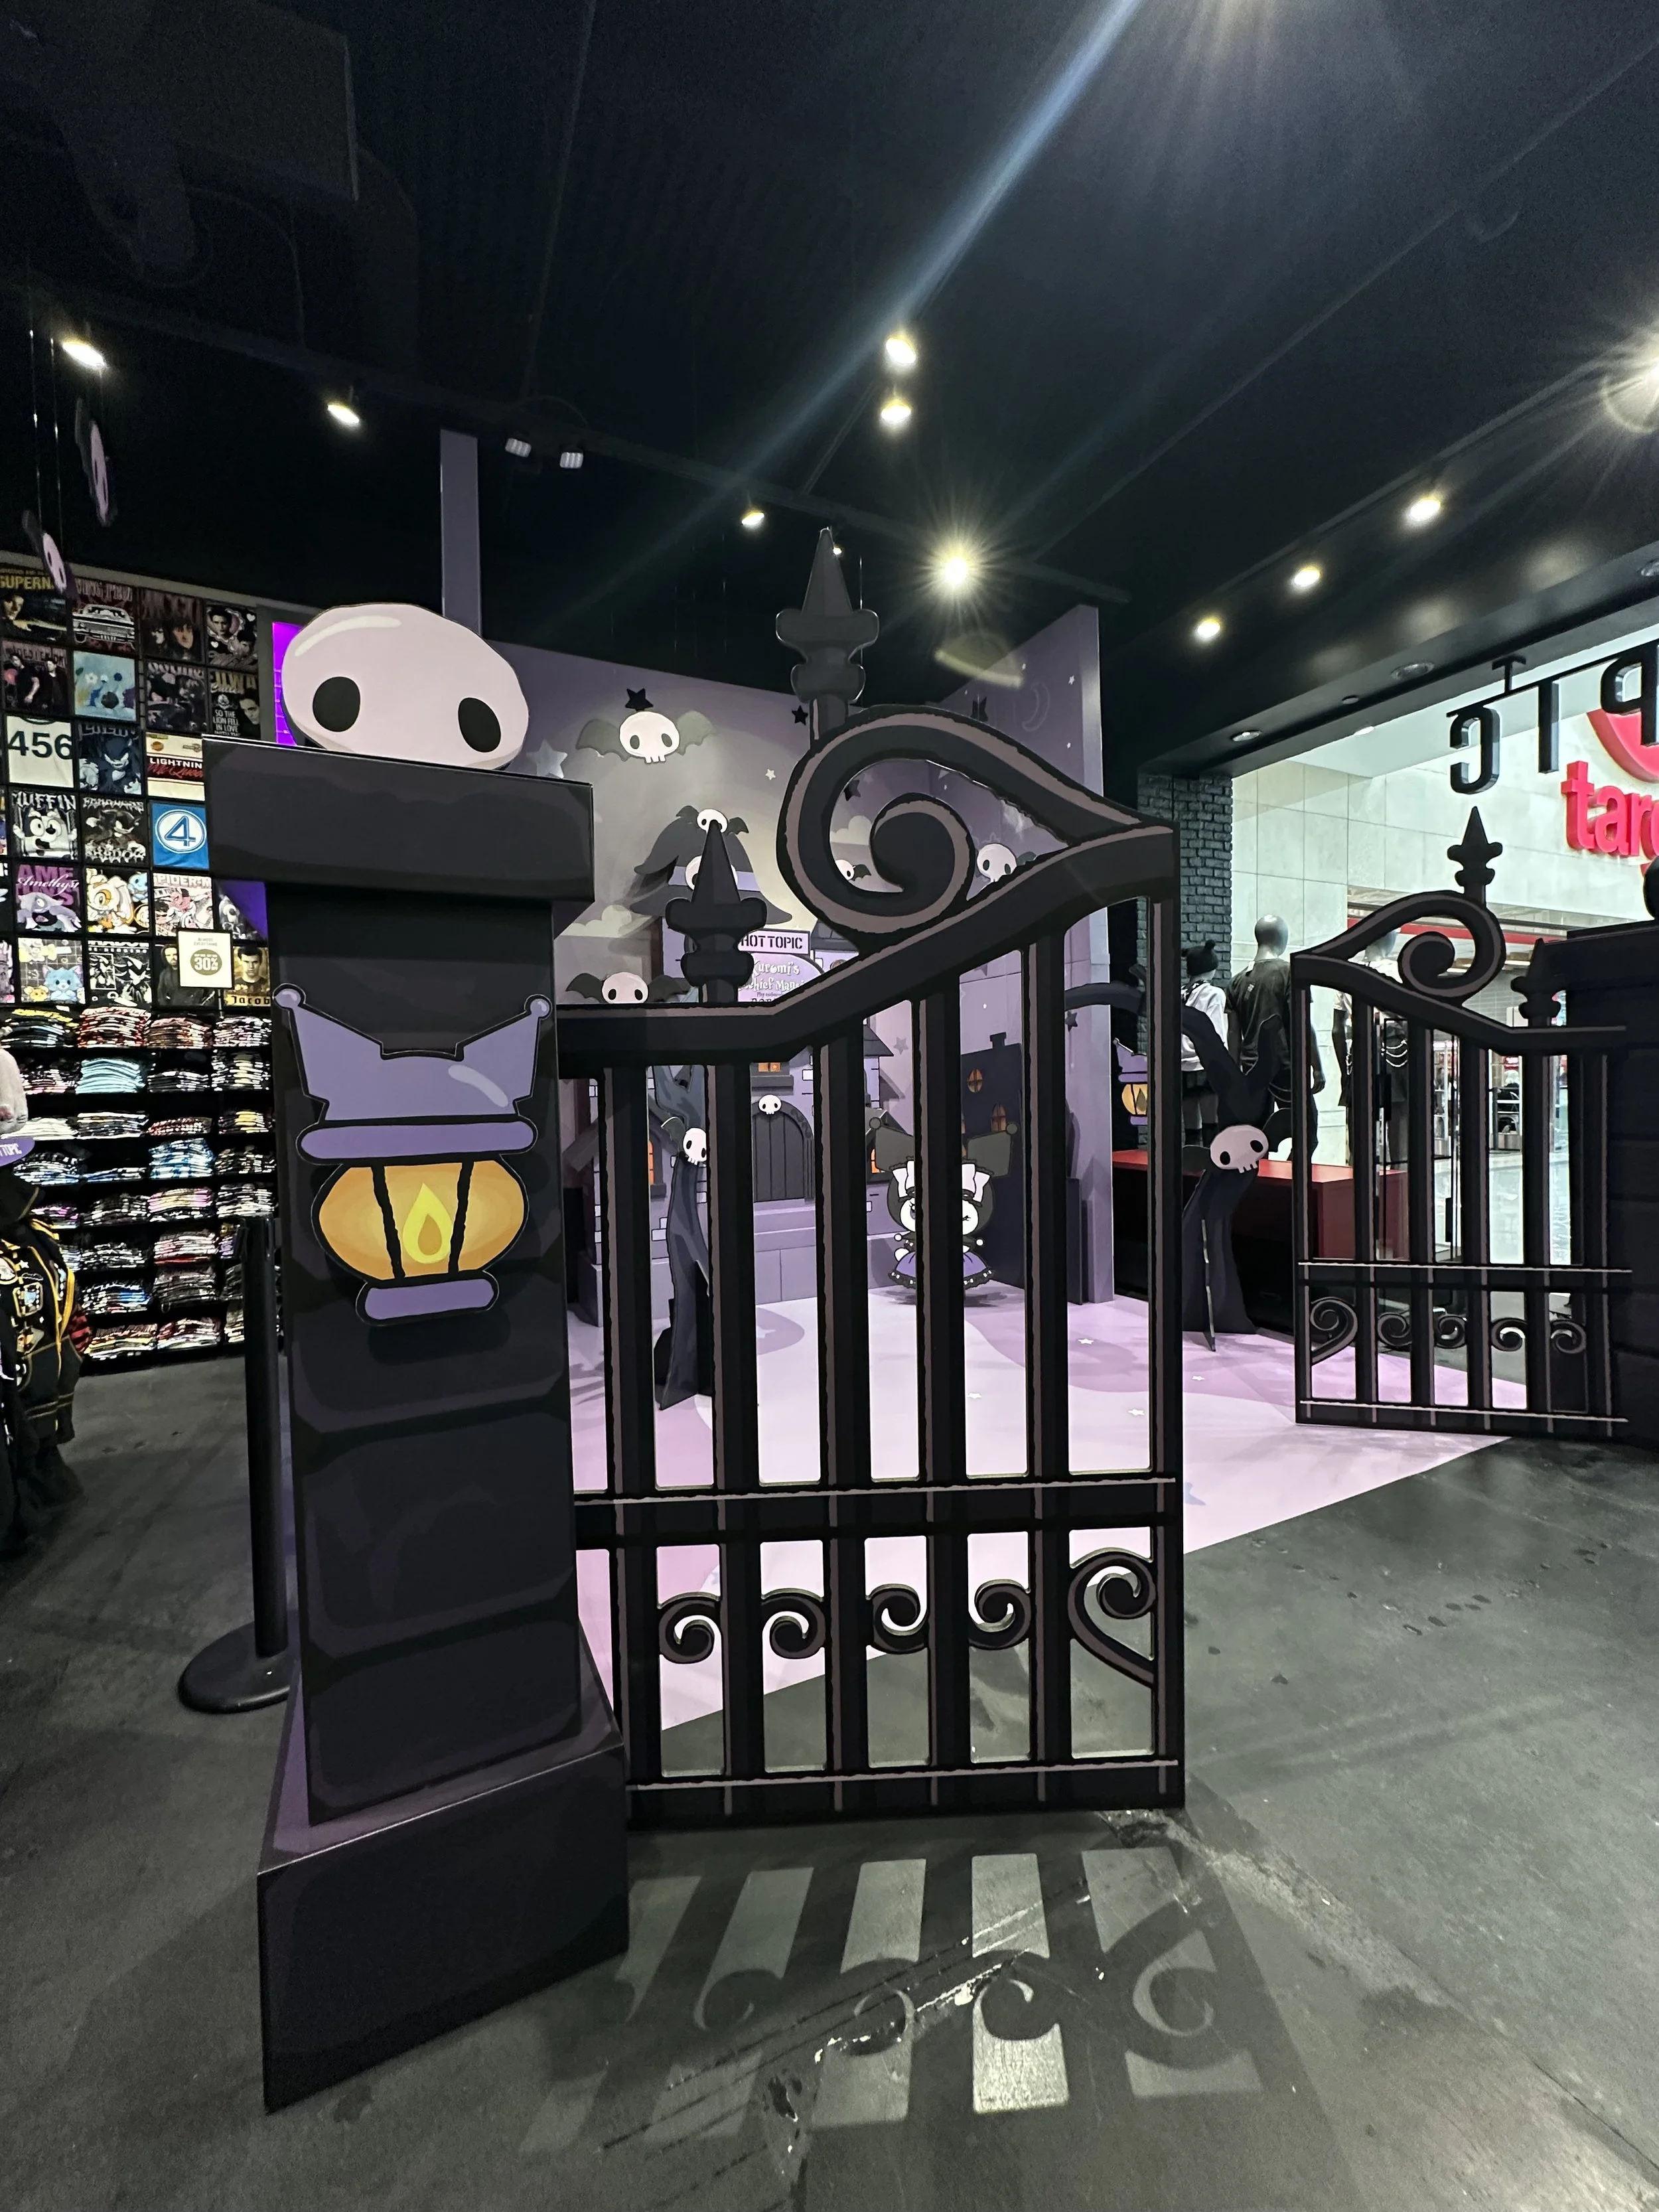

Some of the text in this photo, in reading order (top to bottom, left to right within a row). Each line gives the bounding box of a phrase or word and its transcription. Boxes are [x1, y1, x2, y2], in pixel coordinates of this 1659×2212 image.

[0, 575, 53, 590] SUPERN
[8, 731, 73, 760] 456
[149, 758, 202, 769] LIGHTNIN
[1561, 761, 1659, 875] tar
[164, 816, 196, 847] 4
[741, 934, 802, 949] HOT TOPIC
[231, 995, 270, 1005] Jacob
